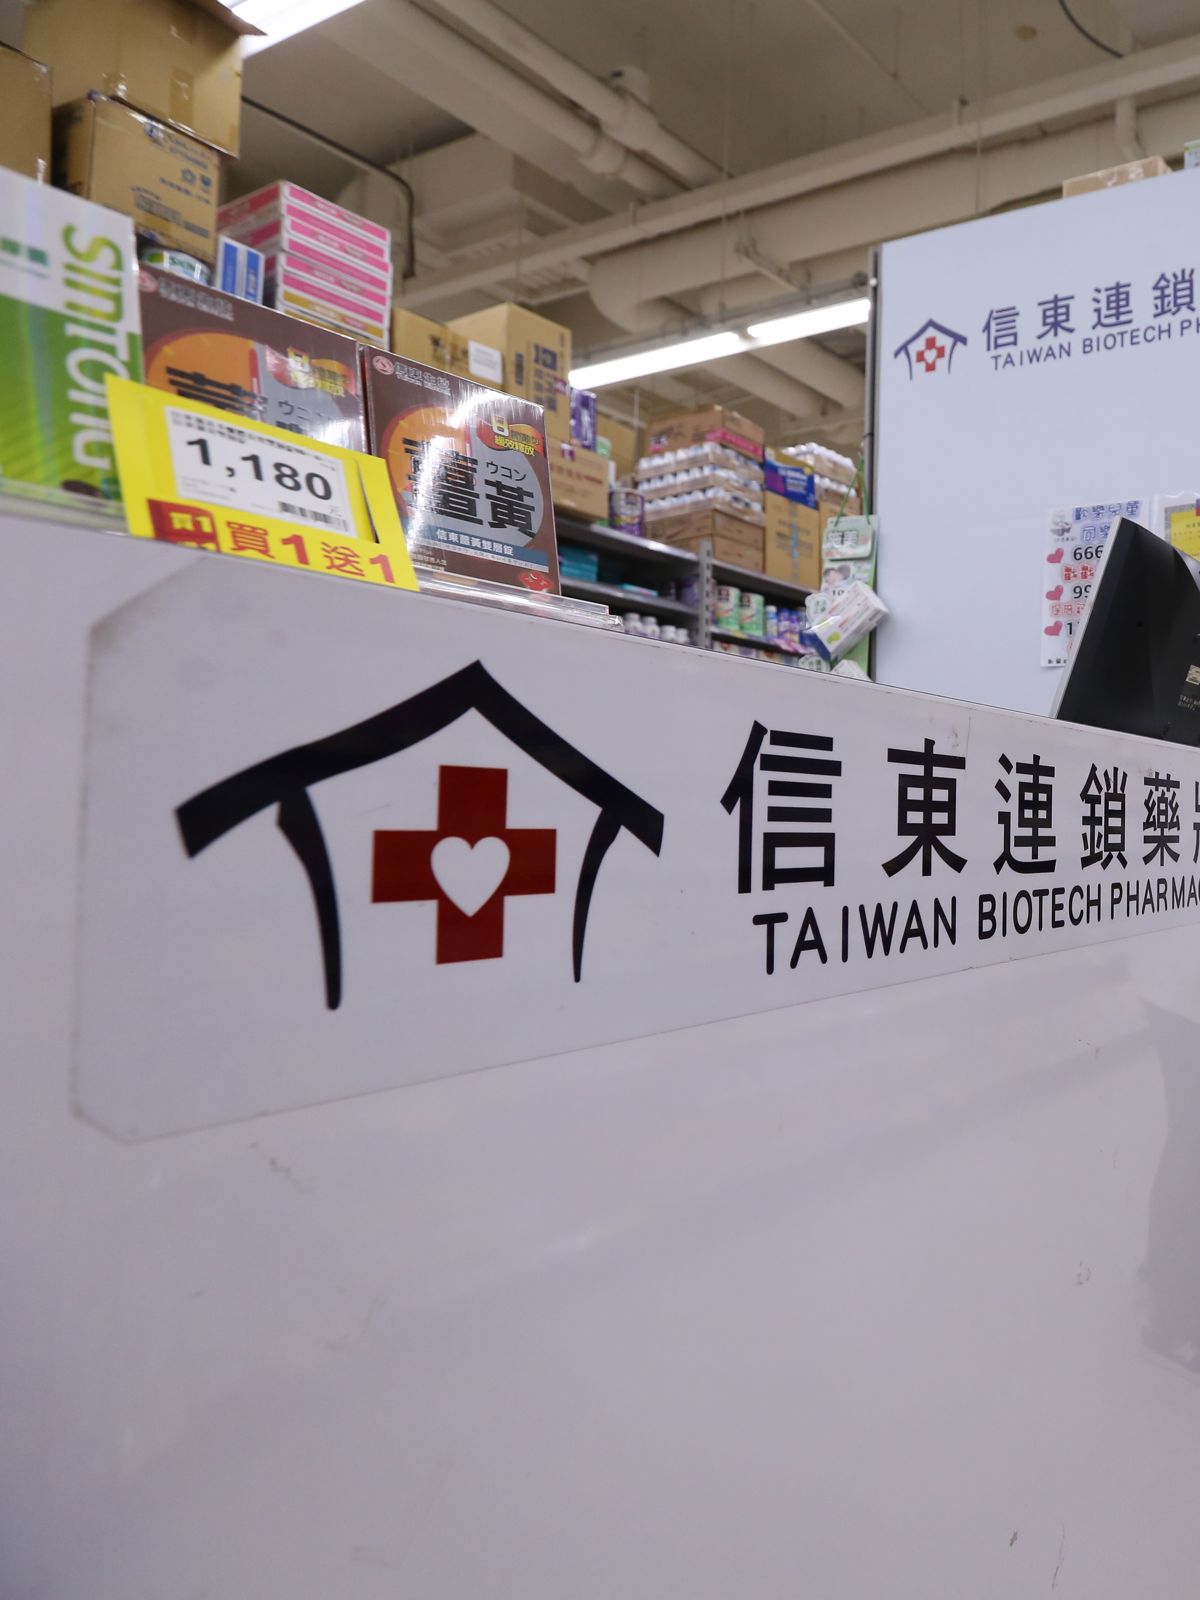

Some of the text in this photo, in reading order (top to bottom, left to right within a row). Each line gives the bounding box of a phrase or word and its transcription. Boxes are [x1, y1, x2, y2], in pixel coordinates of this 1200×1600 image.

[991, 342, 1072, 371] TAIWAN
[1083, 325, 1172, 354] BIOTECH
[186, 437, 333, 501] 1,180
[486, 460, 528, 482] ウコン
[225, 520, 396, 584] 買1送1
[752, 896, 957, 976] TAIWAN
[977, 883, 1101, 940] BIOTECH
